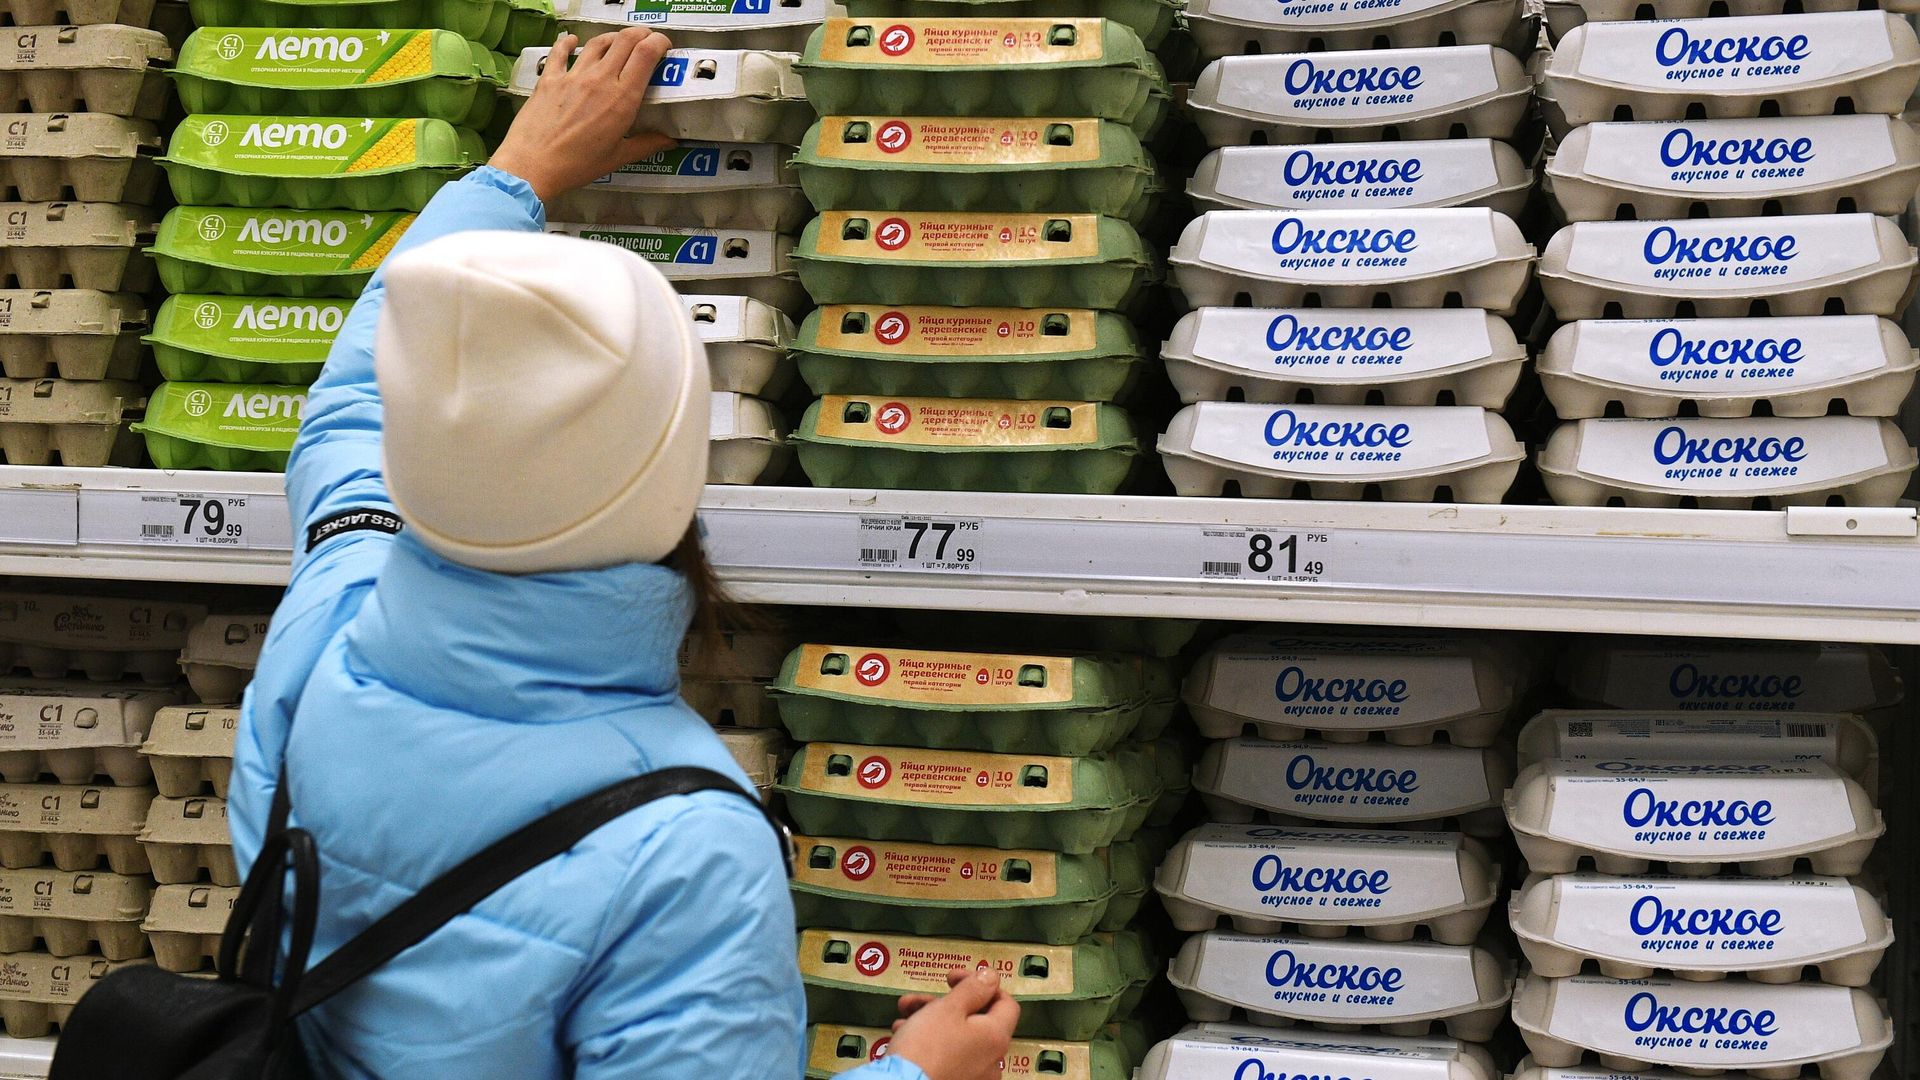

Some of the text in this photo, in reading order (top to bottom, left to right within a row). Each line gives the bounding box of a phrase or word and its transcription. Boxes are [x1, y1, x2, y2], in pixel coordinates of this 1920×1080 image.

[671, 4, 726, 12] ДЕРЕВЕНСКОЕ
[1283, 0, 1400, 17] вкусное и свежее
[633, 13, 662, 21] БЕЛОЕ
[224, 49, 236, 57] 10
[1656, 28, 1811, 68] Окское
[663, 64, 680, 82] С1
[1285, 59, 1424, 98] Окское
[1666, 64, 1800, 81] вкусное и свежее
[1293, 94, 1413, 110] вкусное и свежее
[209, 136, 220, 144] 10
[1661, 129, 1814, 169] Окское
[620, 164, 672, 172] ЕРЕВЕНСКОЕ
[692, 154, 710, 171] С1
[1284, 151, 1423, 188] Окское
[920, 222, 993, 232] Яйца куриные
[205, 230, 217, 238] 10
[922, 231, 988, 240] деревенские
[1272, 218, 1417, 254] Окское
[690, 242, 708, 259] С1
[1644, 227, 1798, 264] Окское
[1280, 257, 1406, 270] вкусное и свежее
[1654, 265, 1787, 280] вкусное и свежее
[201, 318, 213, 326] 10
[918, 316, 992, 326] Яйца куриные
[1017, 322, 1034, 331] 10
[921, 325, 987, 334] деревенские
[1266, 315, 1413, 351] Окское
[1650, 328, 1805, 366] Окское
[1264, 407, 1411, 448] Окское
[1654, 427, 1807, 465] Окское
[1273, 451, 1400, 462] вкусное и свежее
[1665, 466, 1797, 481] вкусное и свежее
[180, 499, 224, 535] 79
[227, 524, 242, 536] 99
[313, 514, 371, 541] JACKET
[960, 522, 978, 530] РУБ
[905, 522, 955, 560] 77
[1308, 534, 1327, 542] РУБ
[957, 549, 974, 561] 99
[1248, 534, 1296, 573] 81
[1304, 562, 1323, 574] 49
[899, 659, 972, 671] Яйца куриные
[901, 669, 966, 679] деревенские
[996, 669, 1013, 679] 10
[1276, 667, 1408, 703] Окское
[1669, 664, 1804, 698] Окское
[1284, 706, 1399, 717] вкусное и свежее
[900, 761, 972, 773] Яйца куриные
[902, 771, 966, 782] деревенские
[996, 771, 1013, 781] 10
[1286, 755, 1419, 796] Окское
[1624, 788, 1775, 827] Окское
[1635, 830, 1765, 844] вкусное и свежее
[884, 852, 956, 864] Яйца куриные
[886, 862, 950, 874] деревенские
[980, 862, 997, 873] 10
[1252, 855, 1391, 894] Окское
[1261, 896, 1380, 907] вкусное и свежее
[1630, 896, 1783, 935] Окское
[1641, 940, 1773, 952] вкусное и свежее
[899, 949, 971, 961] Яйца куриные
[901, 959, 966, 969] деревенские
[997, 961, 1013, 970] 10
[1266, 950, 1404, 994] Окское
[1274, 991, 1393, 1004] вкусное и свежее
[1625, 992, 1778, 1038] Окское
[1012, 1056, 1030, 1067] 10
